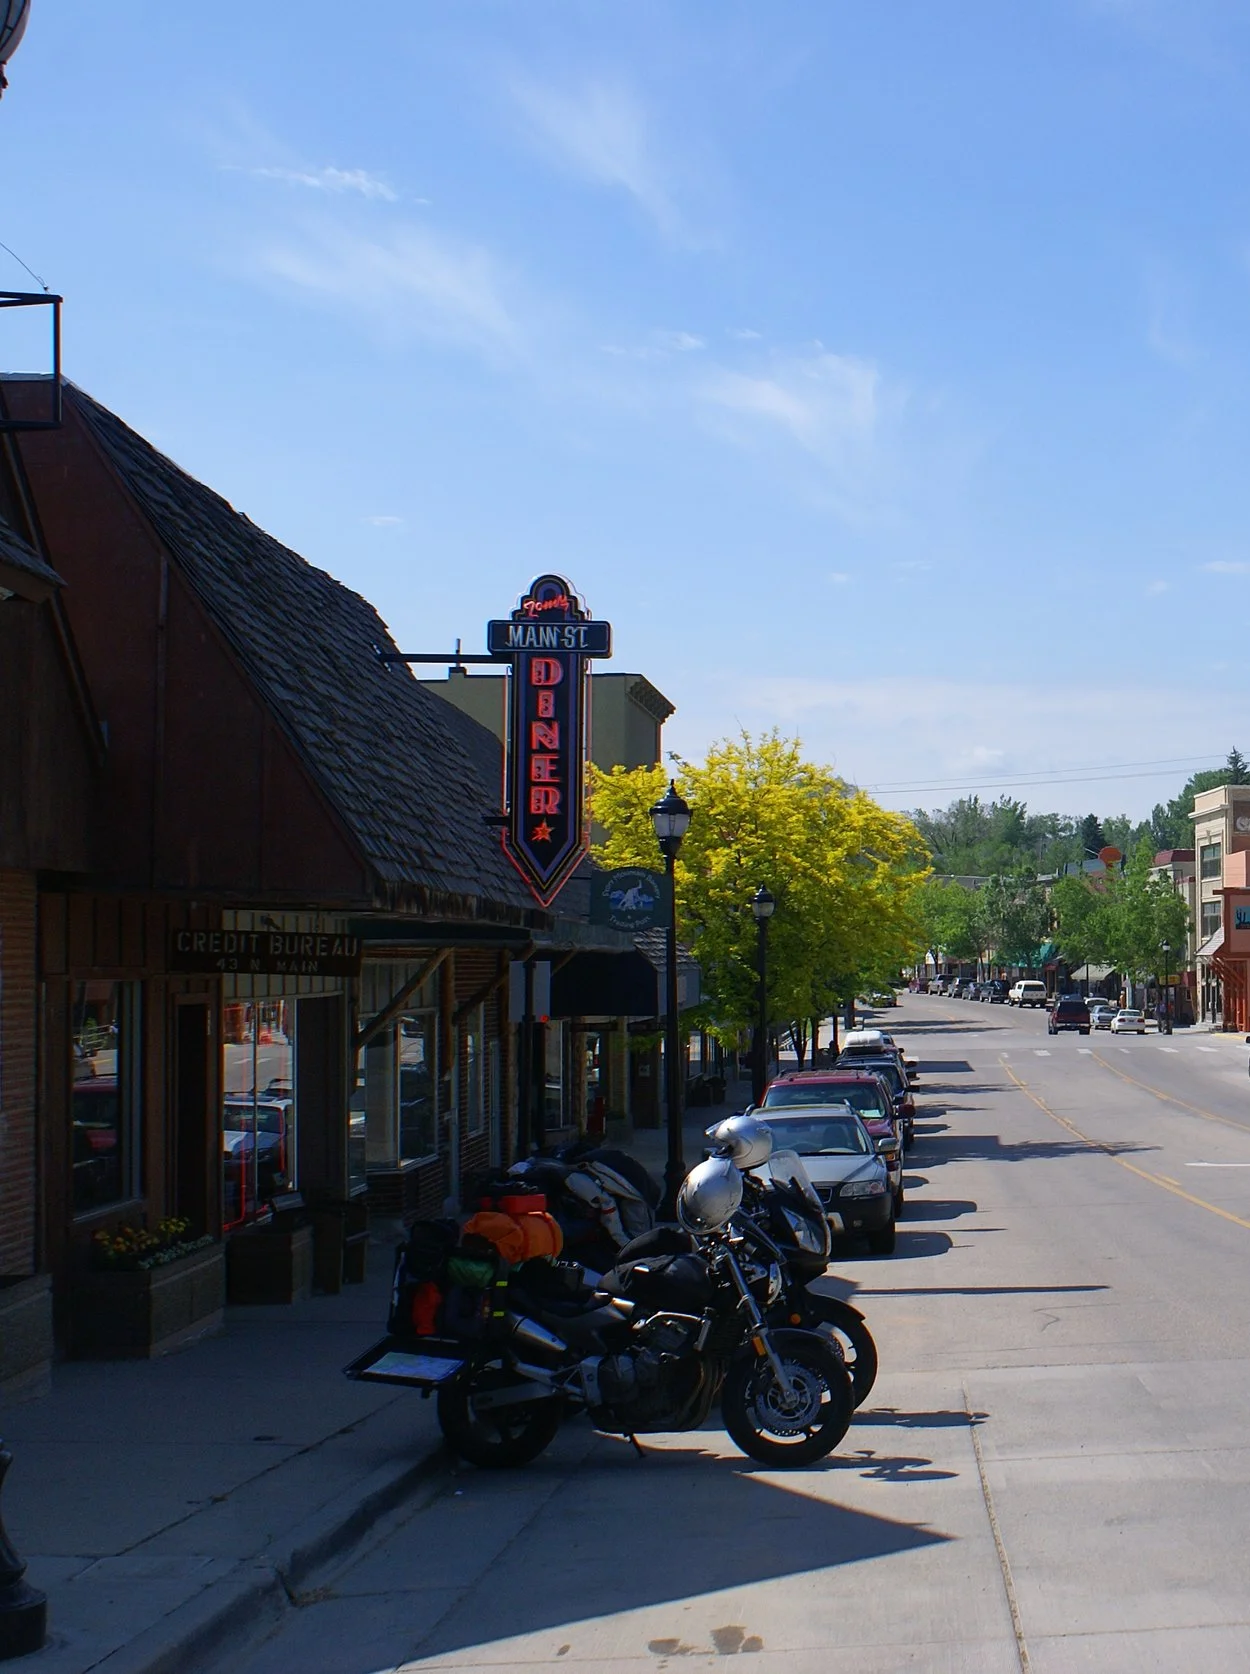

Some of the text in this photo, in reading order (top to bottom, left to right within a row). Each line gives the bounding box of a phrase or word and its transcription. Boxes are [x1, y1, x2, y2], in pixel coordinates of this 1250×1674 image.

[529, 657, 564, 815] DINER
[177, 931, 358, 957] CREDIT BUREAU
[216, 958, 238, 970] 43
[276, 960, 318, 973] MAIN
